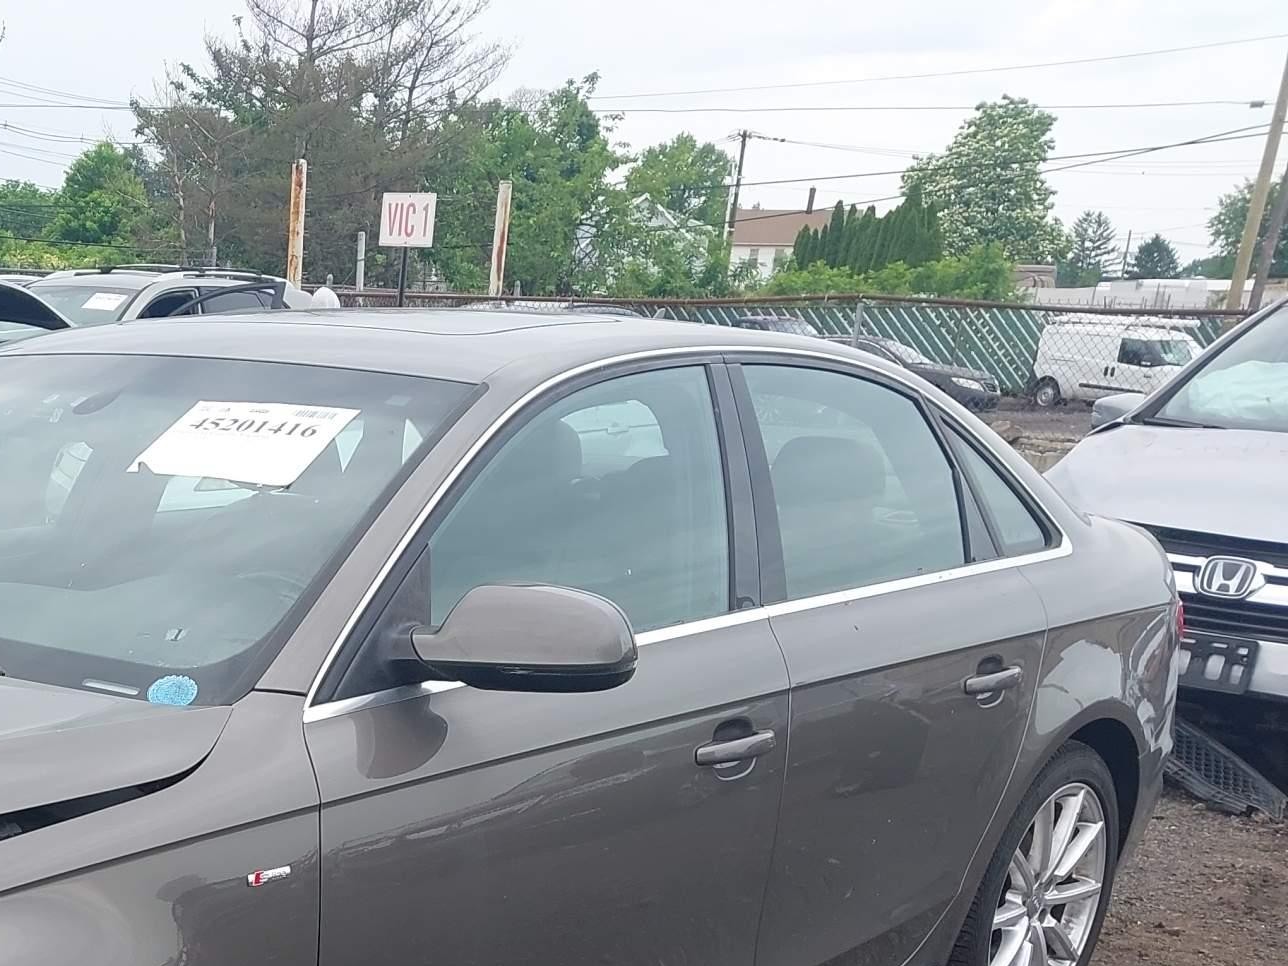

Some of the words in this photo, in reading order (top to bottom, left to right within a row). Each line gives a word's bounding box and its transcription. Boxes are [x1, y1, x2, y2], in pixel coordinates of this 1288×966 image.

[388, 202, 416, 237] VIC
[423, 202, 429, 237] 1
[189, 417, 320, 438] 45201416
